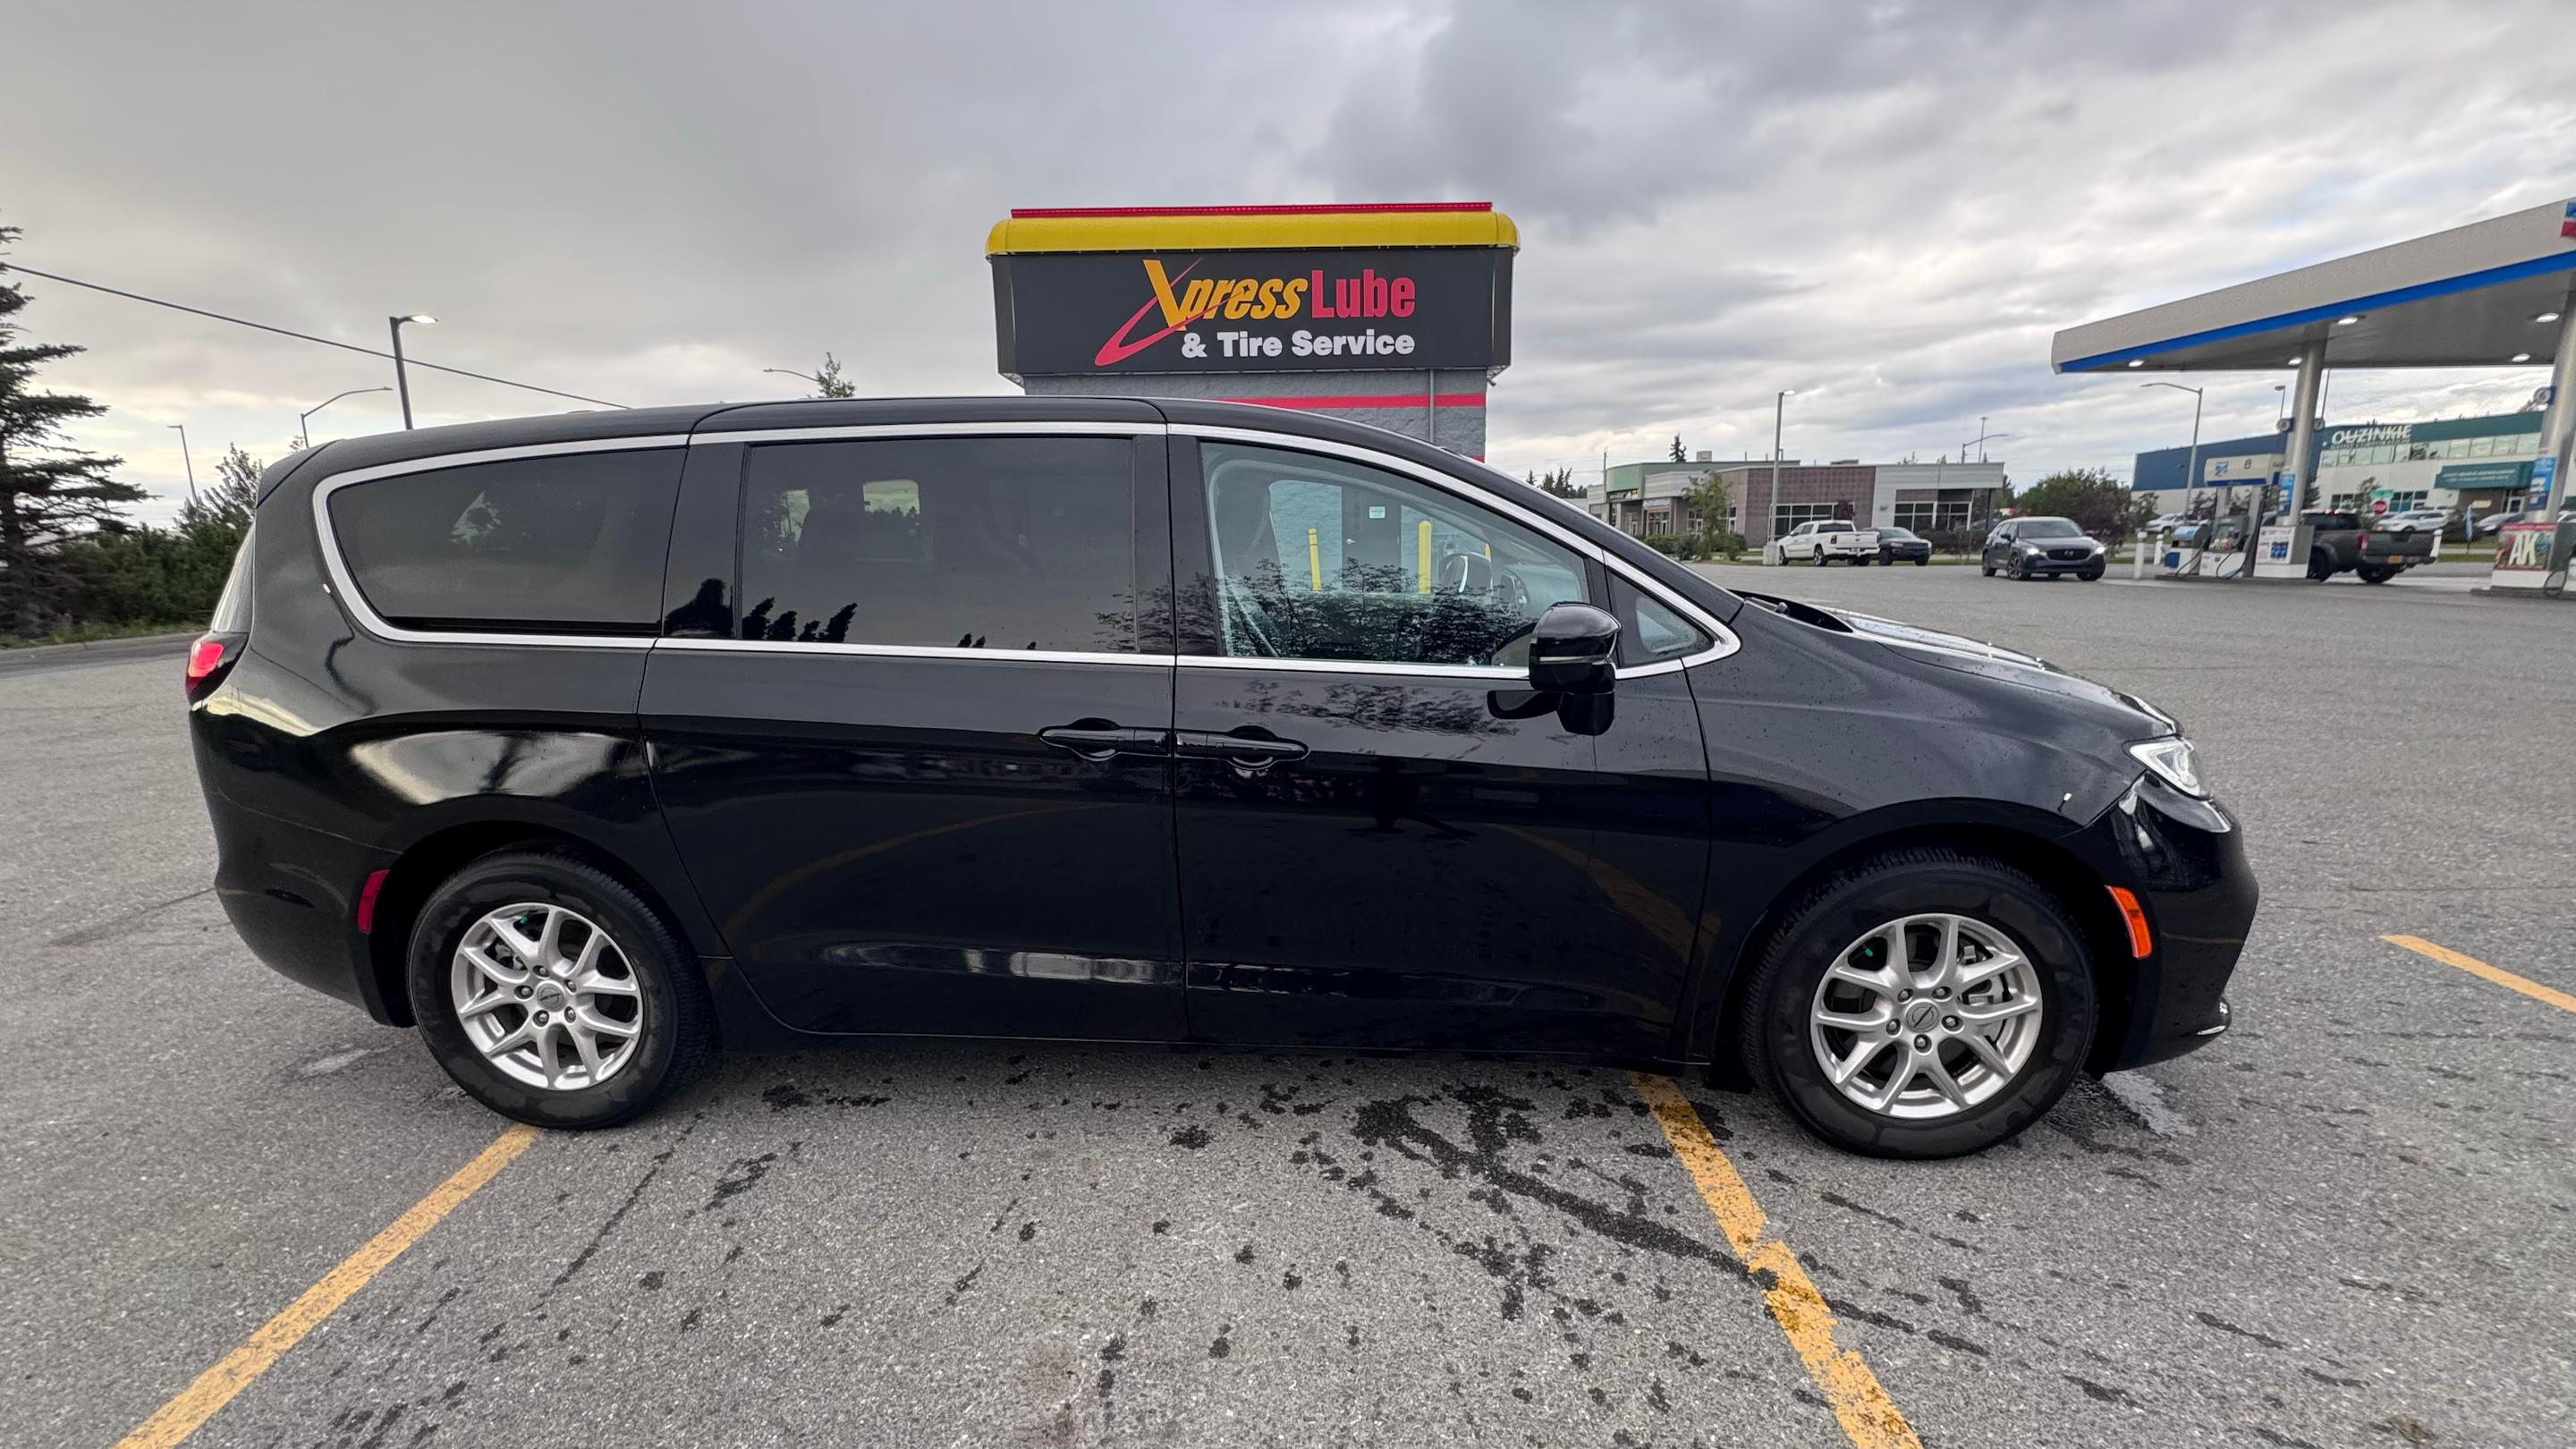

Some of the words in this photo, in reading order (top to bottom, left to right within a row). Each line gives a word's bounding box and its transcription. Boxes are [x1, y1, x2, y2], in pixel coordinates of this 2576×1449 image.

[1311, 268, 1416, 318] Lube
[1182, 332, 1208, 359] &
[1216, 331, 1283, 358] Tire
[1292, 328, 1416, 357] Service
